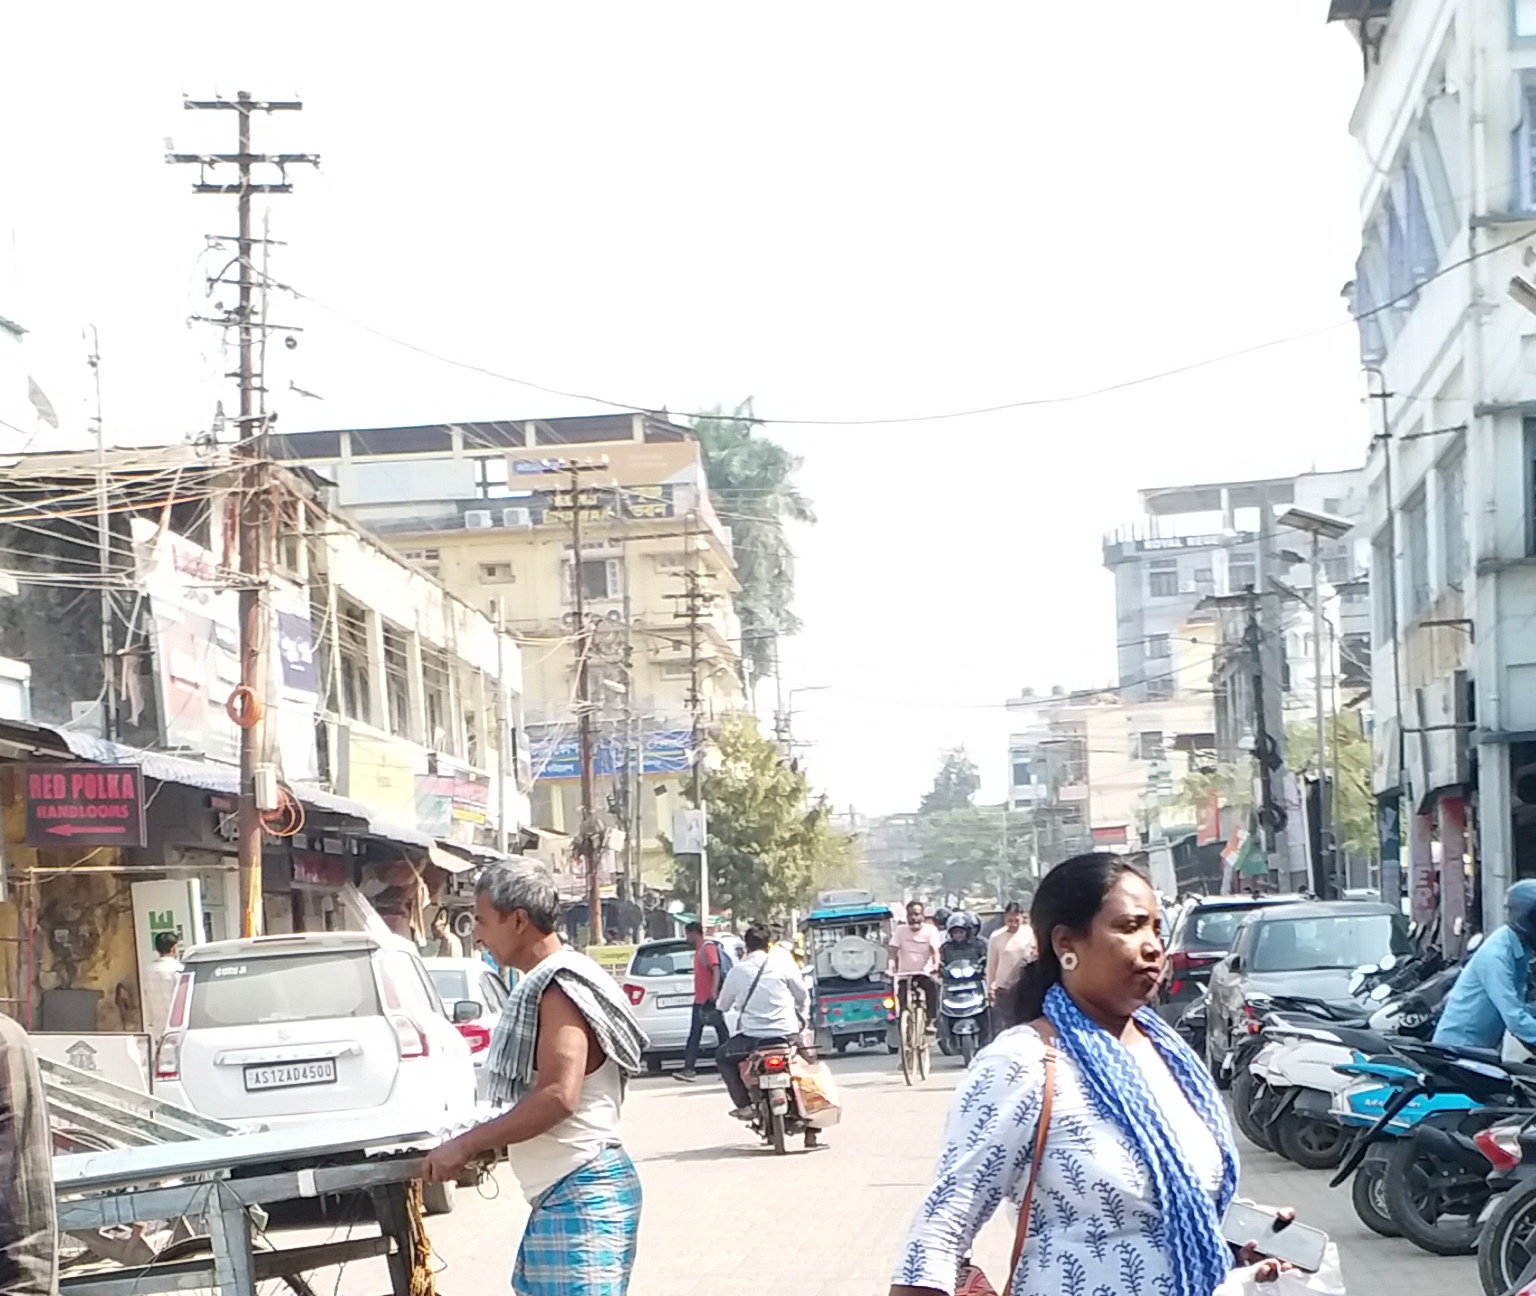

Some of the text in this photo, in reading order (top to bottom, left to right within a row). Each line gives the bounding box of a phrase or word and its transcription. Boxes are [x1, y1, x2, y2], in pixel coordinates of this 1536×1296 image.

[29, 773, 135, 799] RED POLKA
[36, 805, 129, 819] HANDLOOMS
